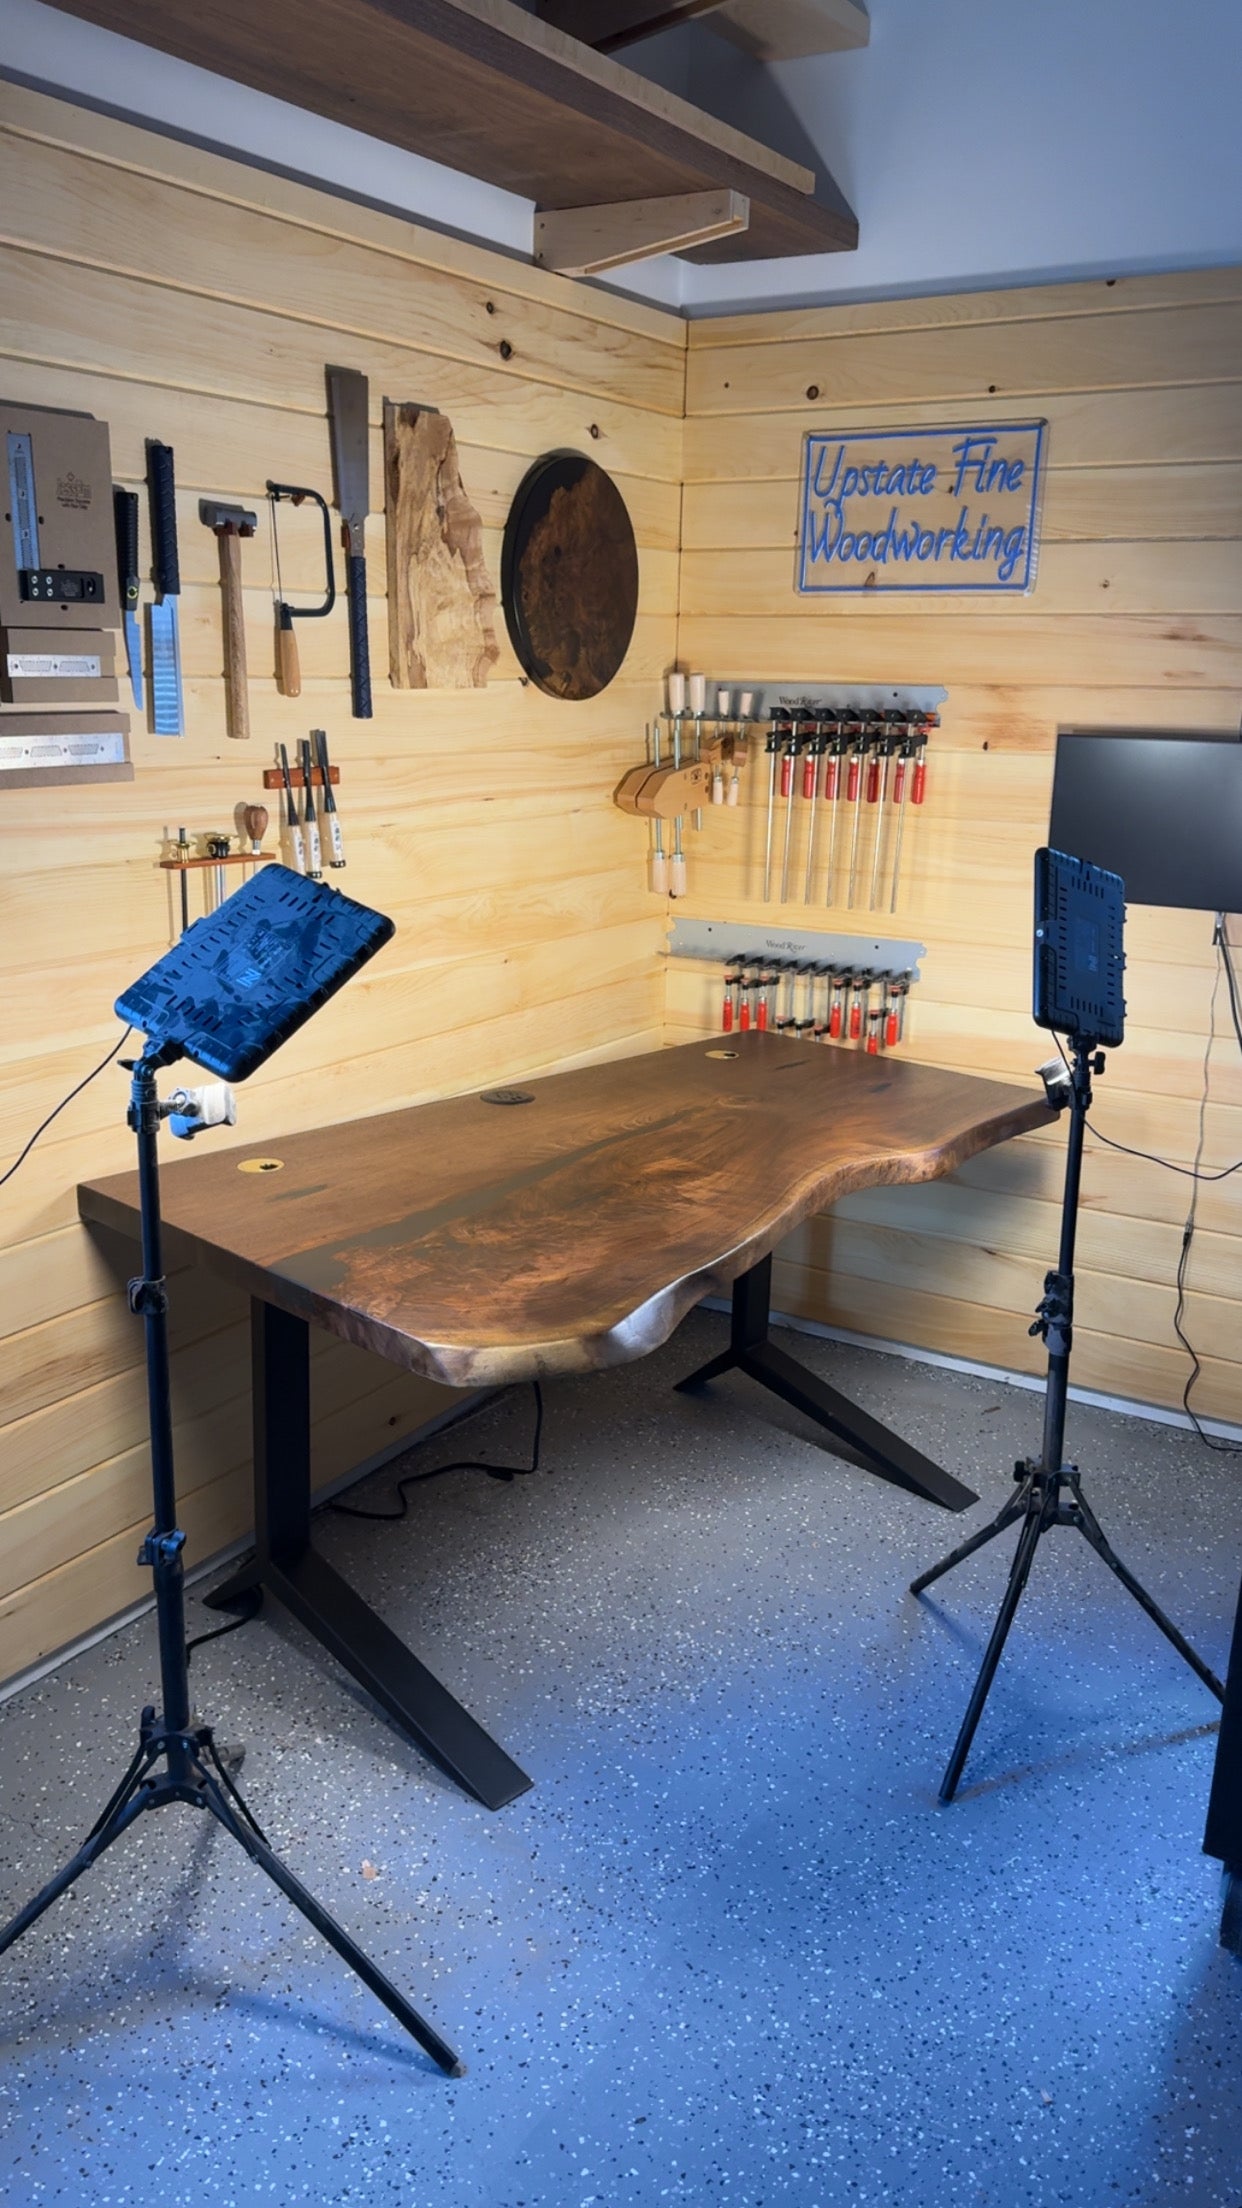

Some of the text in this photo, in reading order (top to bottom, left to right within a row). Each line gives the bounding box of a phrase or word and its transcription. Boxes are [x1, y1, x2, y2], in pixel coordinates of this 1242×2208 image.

[813, 436, 1025, 513] Upstate Fine
[809, 506, 1026, 582] Woodworking
